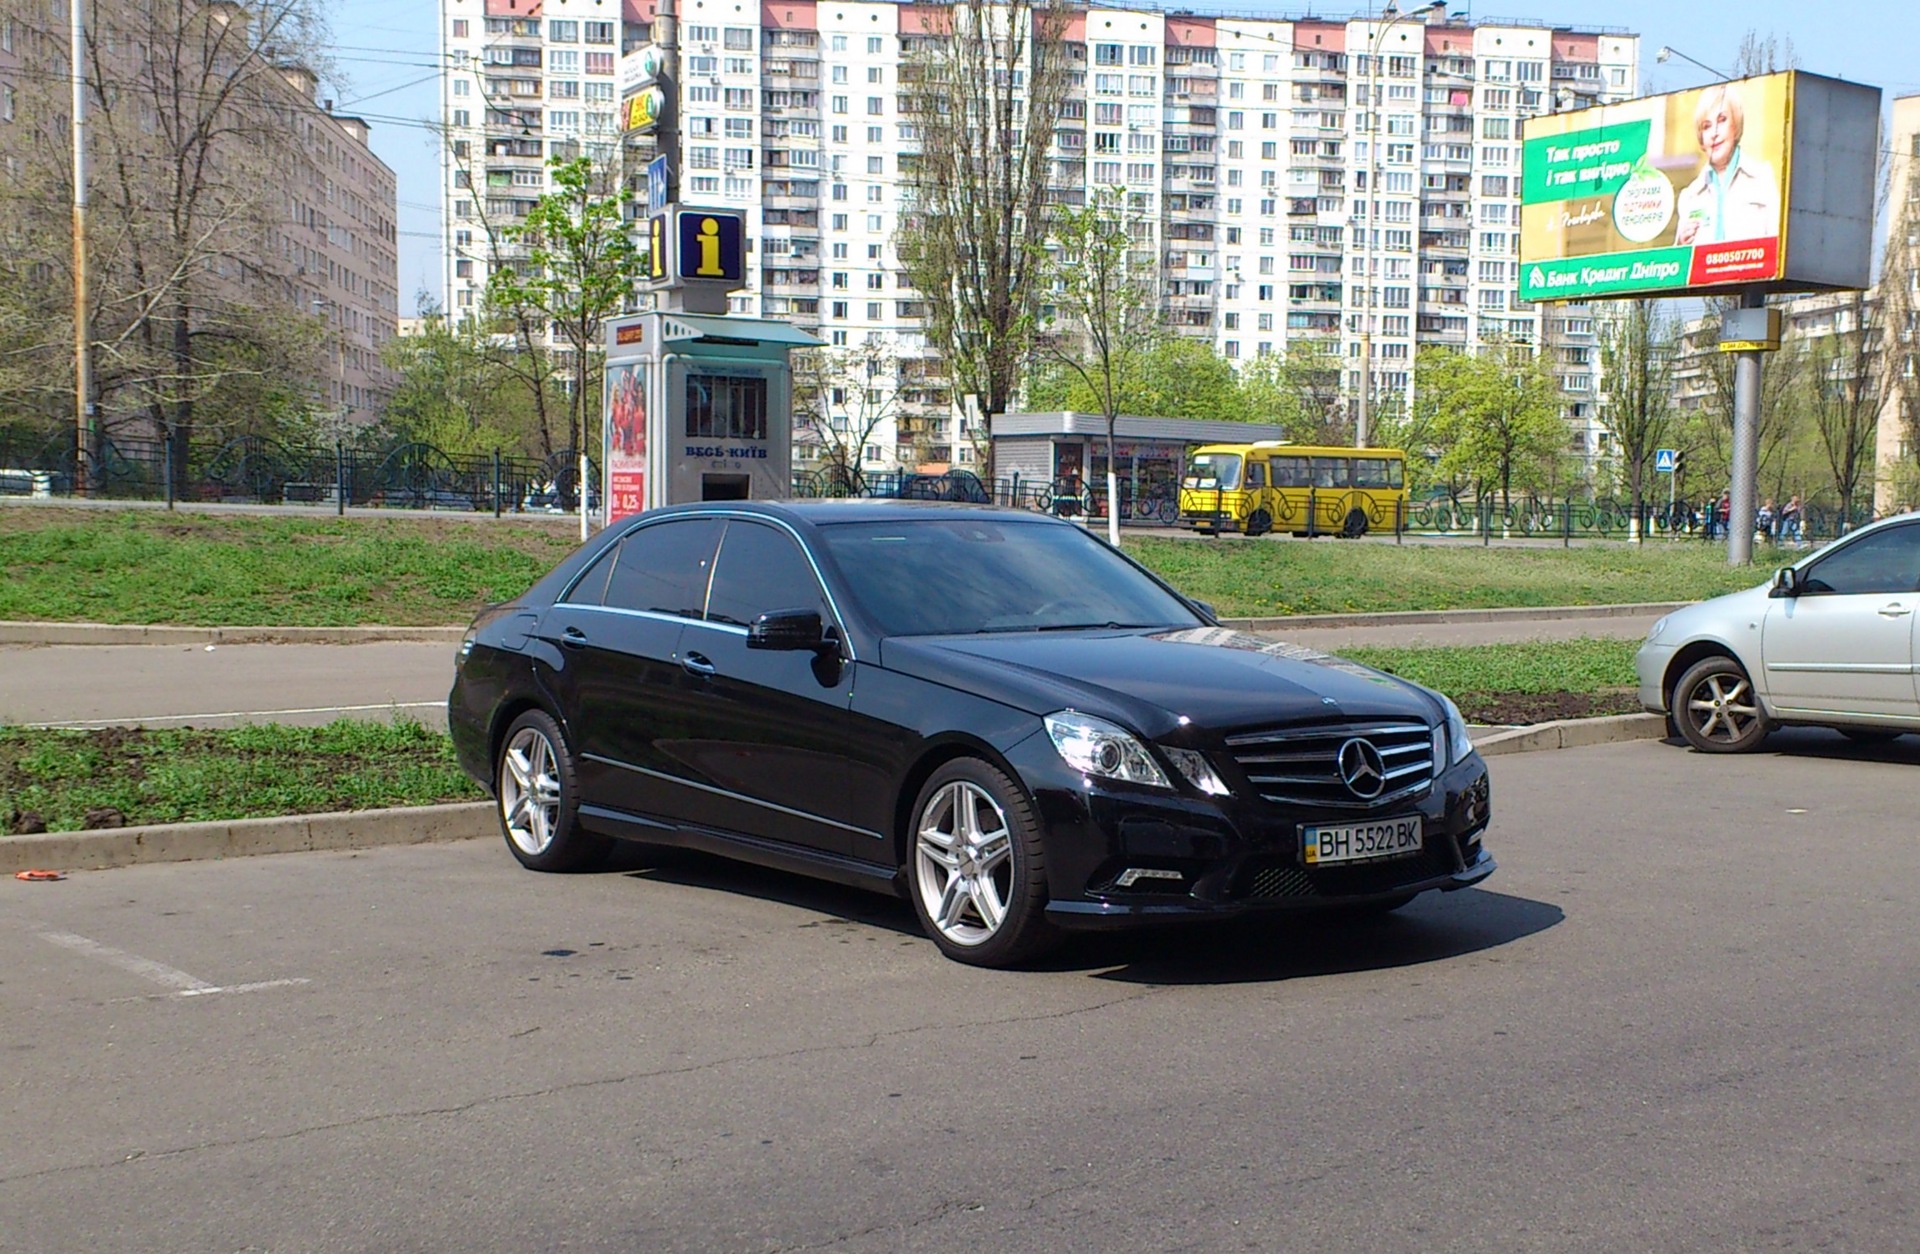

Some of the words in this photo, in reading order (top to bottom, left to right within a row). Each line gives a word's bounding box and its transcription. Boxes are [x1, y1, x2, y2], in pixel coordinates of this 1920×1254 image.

[1546, 146, 1571, 163] Так
[1572, 141, 1620, 162] просто
[1554, 171, 1577, 185] так
[1579, 162, 1630, 182] вигідно
[1706, 249, 1764, 265] 0800507700
[1548, 269, 1577, 287] Банк
[1581, 267, 1628, 287] Кредит
[1631, 262, 1680, 282] Дніпро
[1319, 830, 1350, 857] BH
[1355, 825, 1394, 853] 5522
[1397, 821, 1418, 847] BK
